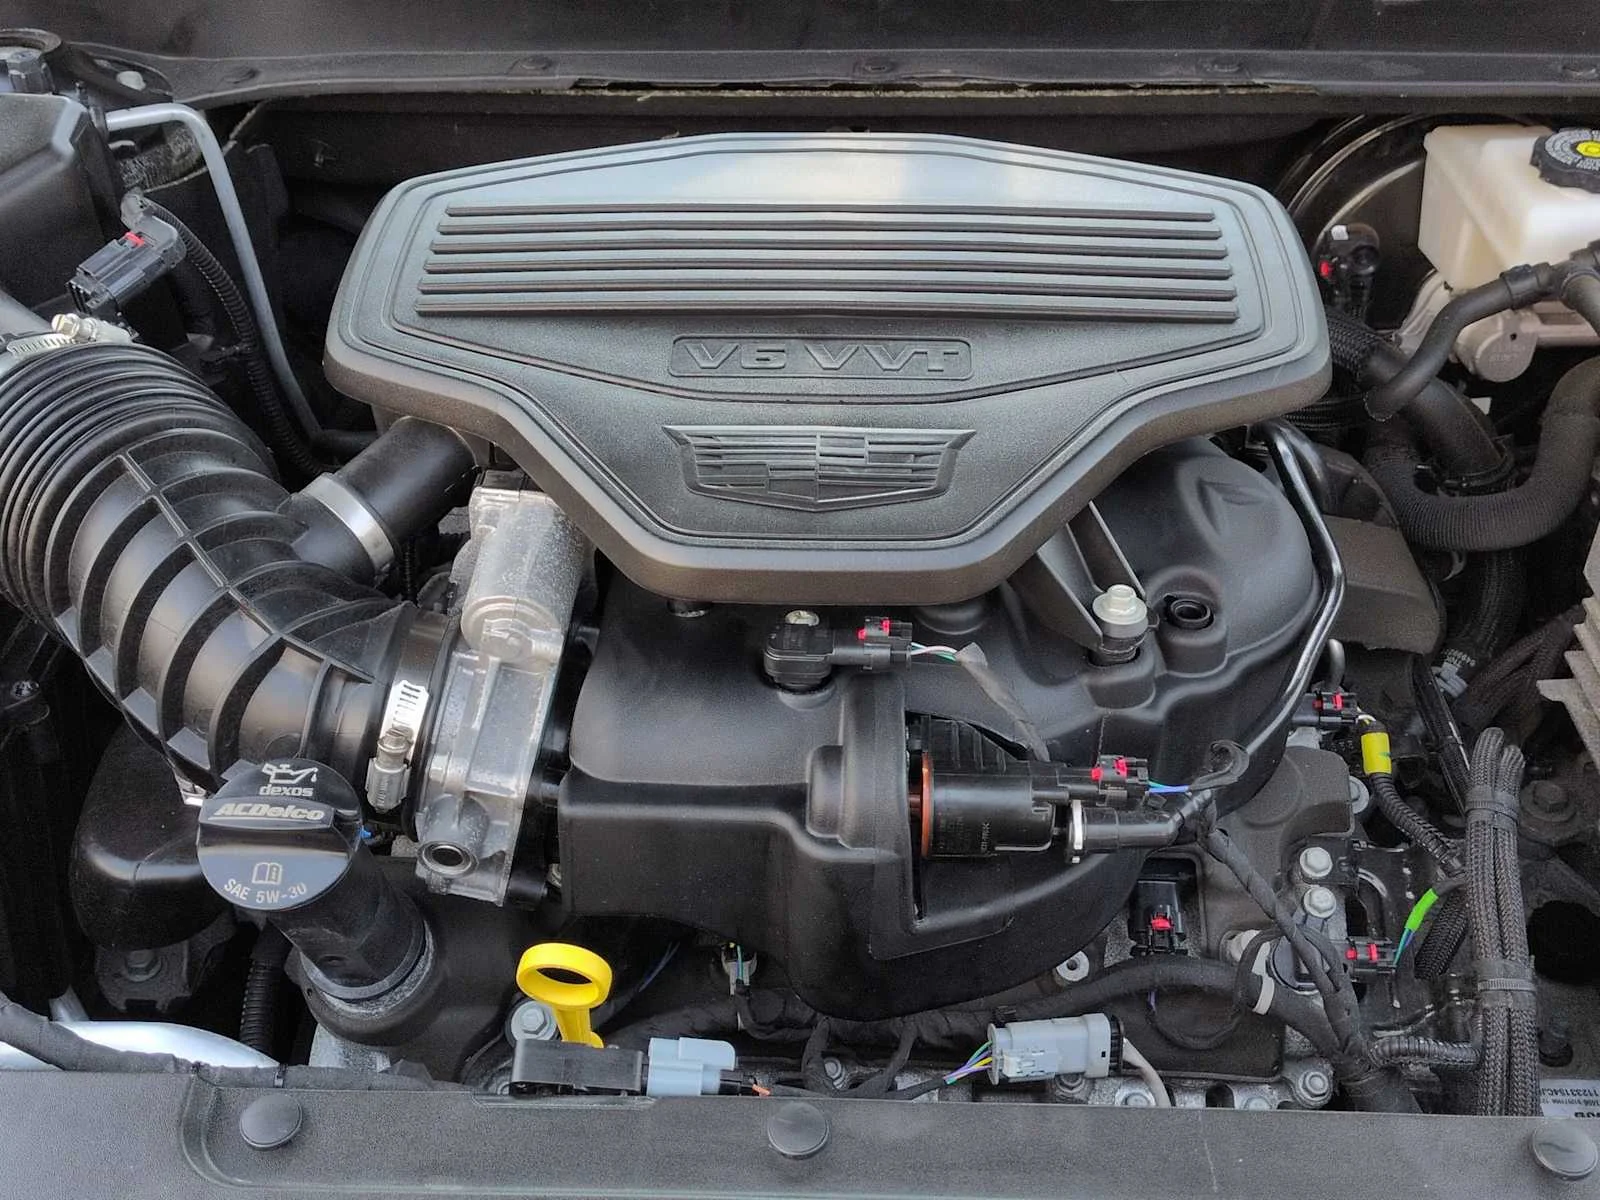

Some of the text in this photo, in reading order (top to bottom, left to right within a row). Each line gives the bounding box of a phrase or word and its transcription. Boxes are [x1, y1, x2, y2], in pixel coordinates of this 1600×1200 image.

[684, 343, 960, 373] V6 VVT
[259, 784, 314, 797] dexos
[213, 802, 325, 820] ACDelco
[224, 877, 307, 903] SAE 5W-30
